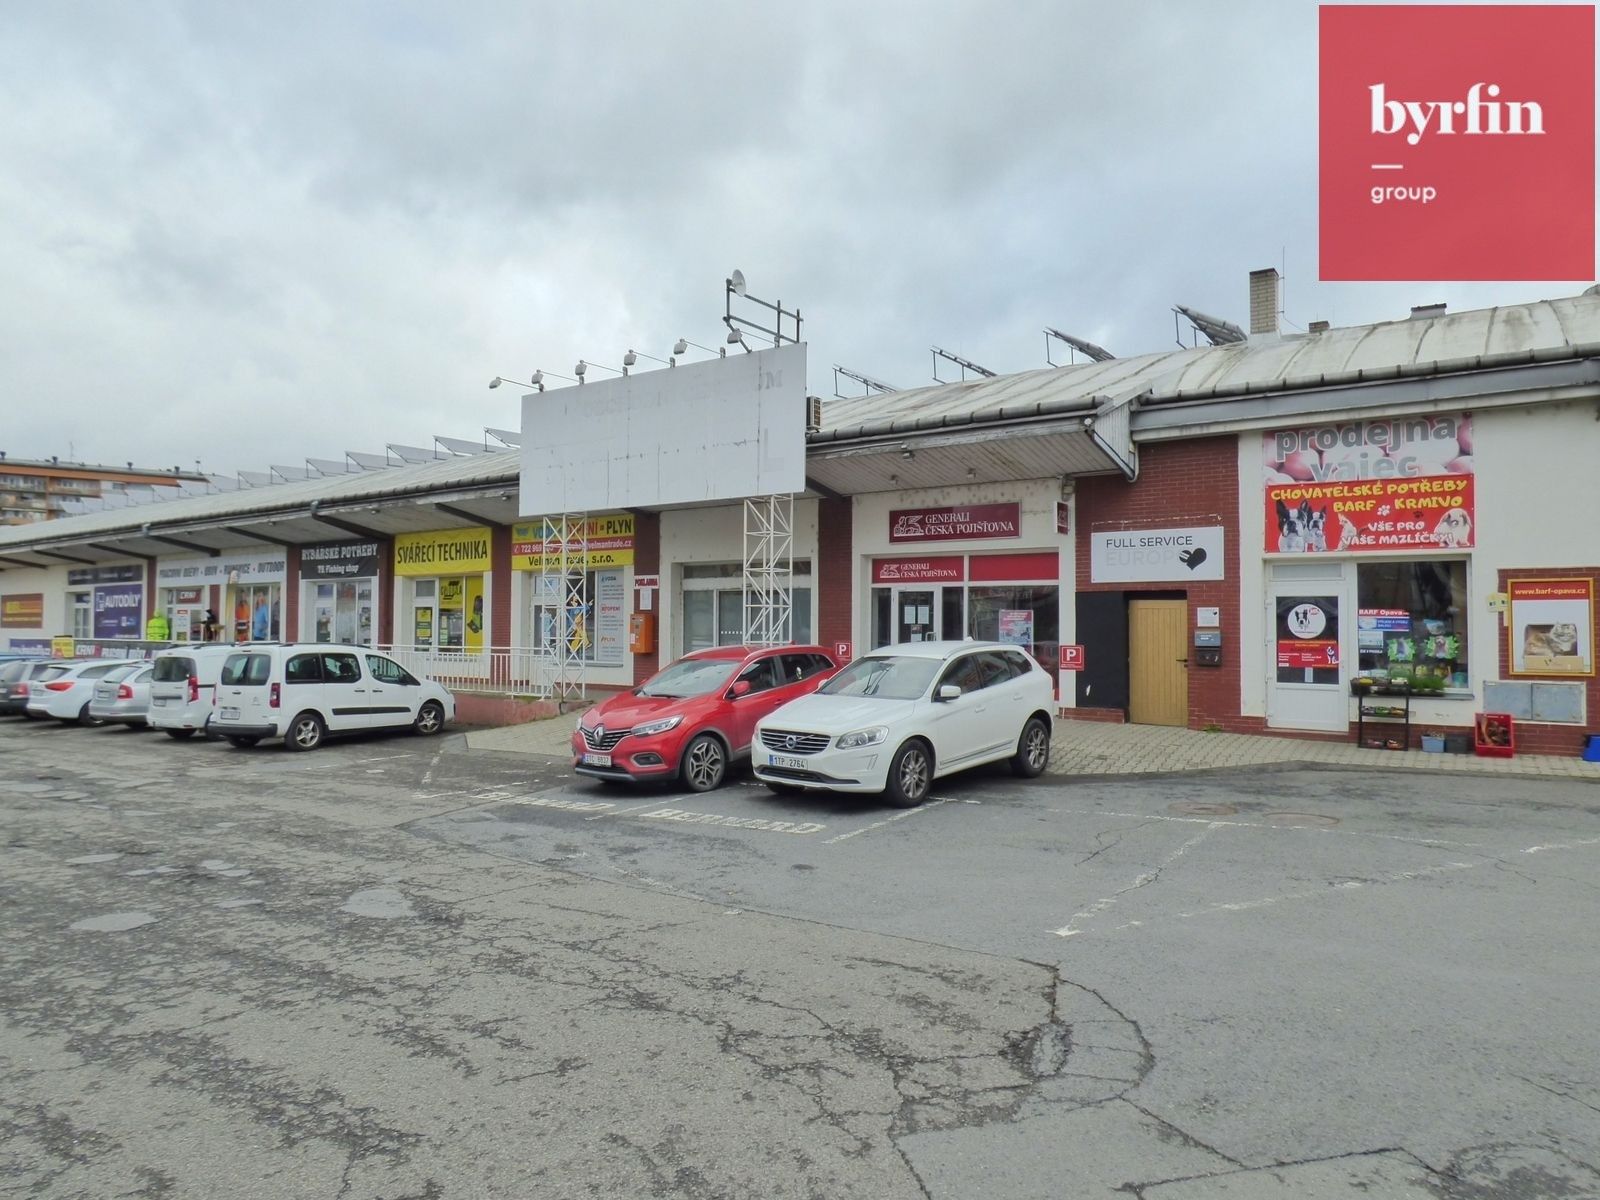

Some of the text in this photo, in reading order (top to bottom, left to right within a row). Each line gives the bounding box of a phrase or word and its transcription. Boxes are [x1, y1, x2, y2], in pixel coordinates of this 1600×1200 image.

[1275, 417, 1456, 462] prodejna
[1270, 479, 1467, 500] CHOVATELSKÉ POTŘEBY
[1333, 496, 1463, 512] BARF KRMIVO
[925, 512, 970, 524] GENERALI
[606, 519, 632, 534] PLYN
[925, 520, 1014, 535] ČESKÁ POJIŠŤOVNA
[1367, 520, 1425, 532] VŠE PRO
[1106, 536, 1193, 549] FULL SERVICE
[1341, 534, 1376, 545] VAŠE
[302, 543, 378, 560] RYBÁŘSKÉ POTŘEBY
[397, 540, 488, 564] SVÁŘECÍ TECHNIKA
[591, 554, 614, 564] s.r.o.
[900, 563, 930, 571] GENERALI
[900, 569, 919, 578] ČESKÁ
[1514, 587, 1586, 596] www.barf-opava.cz
[105, 591, 140, 608] AUTODÍLY
[839, 644, 847, 655] P
[1066, 648, 1076, 661] P
